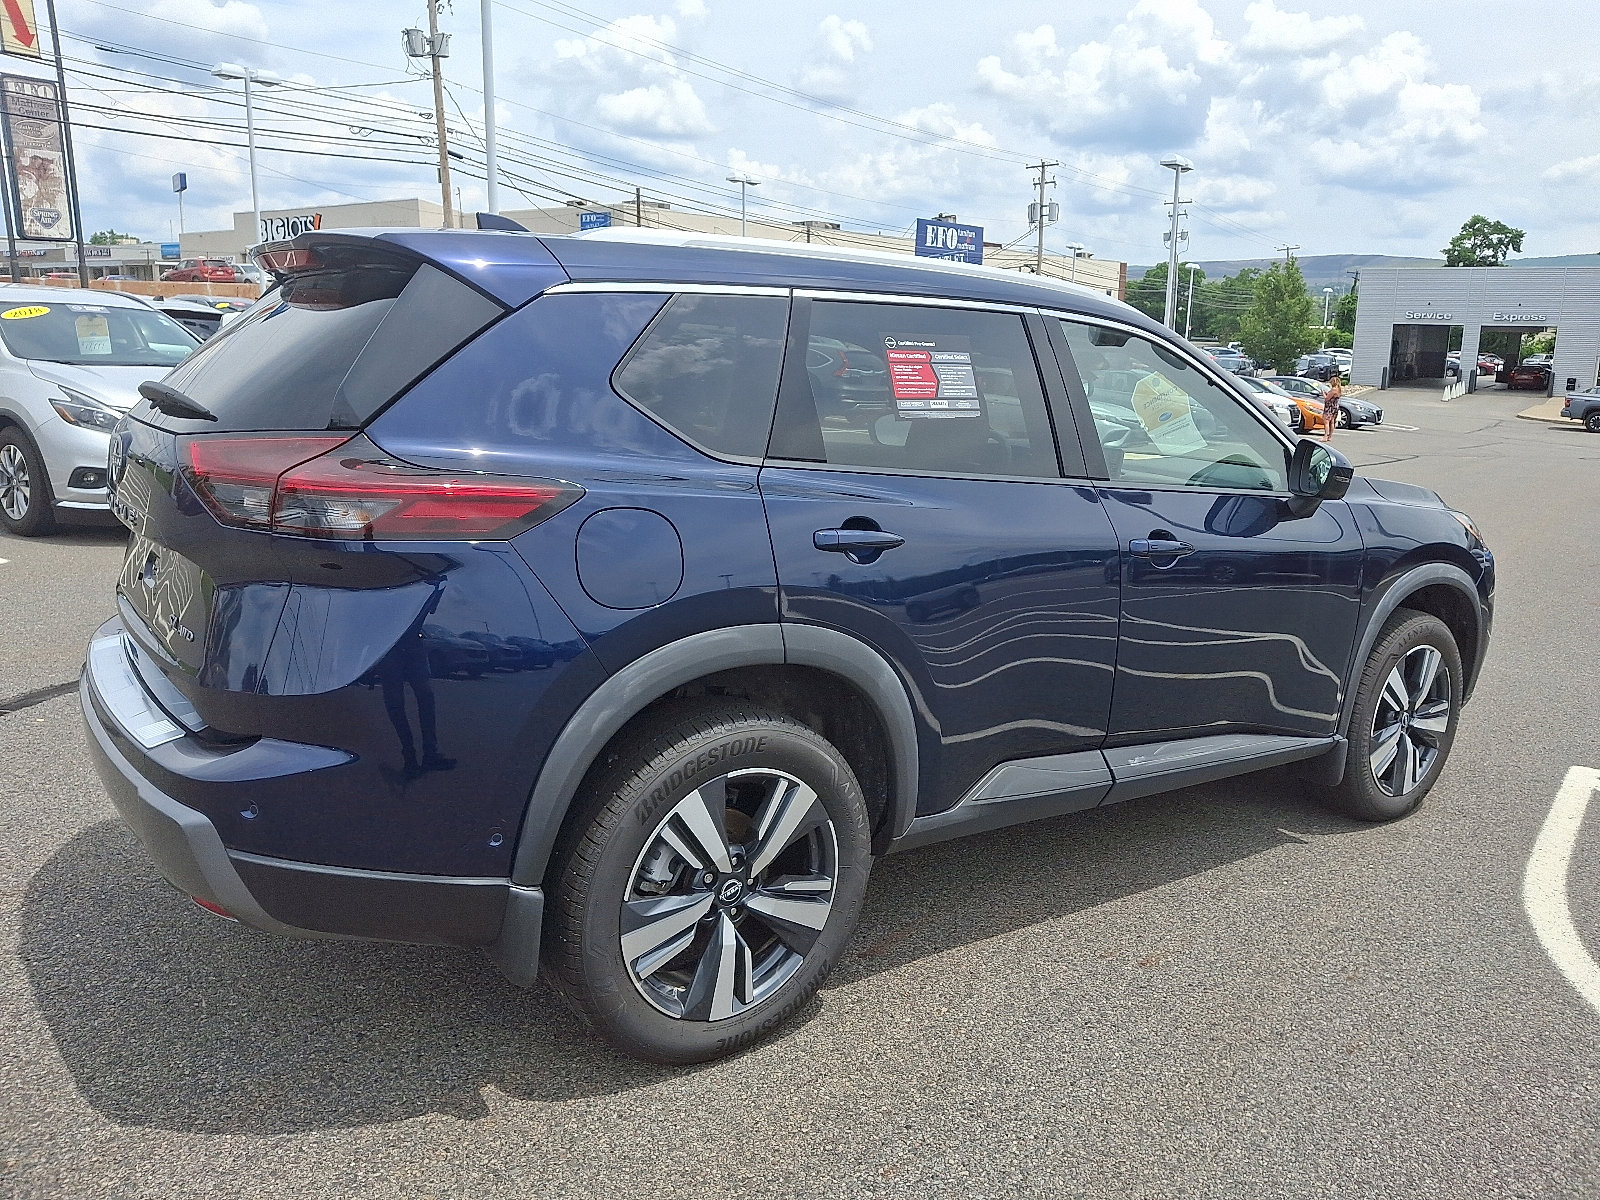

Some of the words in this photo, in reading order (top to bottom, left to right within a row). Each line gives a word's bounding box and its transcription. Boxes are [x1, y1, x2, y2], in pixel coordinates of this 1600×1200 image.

[19, 107, 50, 118] Center
[33, 208, 58, 219] SPRING
[925, 225, 958, 249] EFO
[1405, 310, 1452, 321] Service
[1492, 312, 1547, 323] Express
[634, 736, 768, 824] BRIDGESTONE
